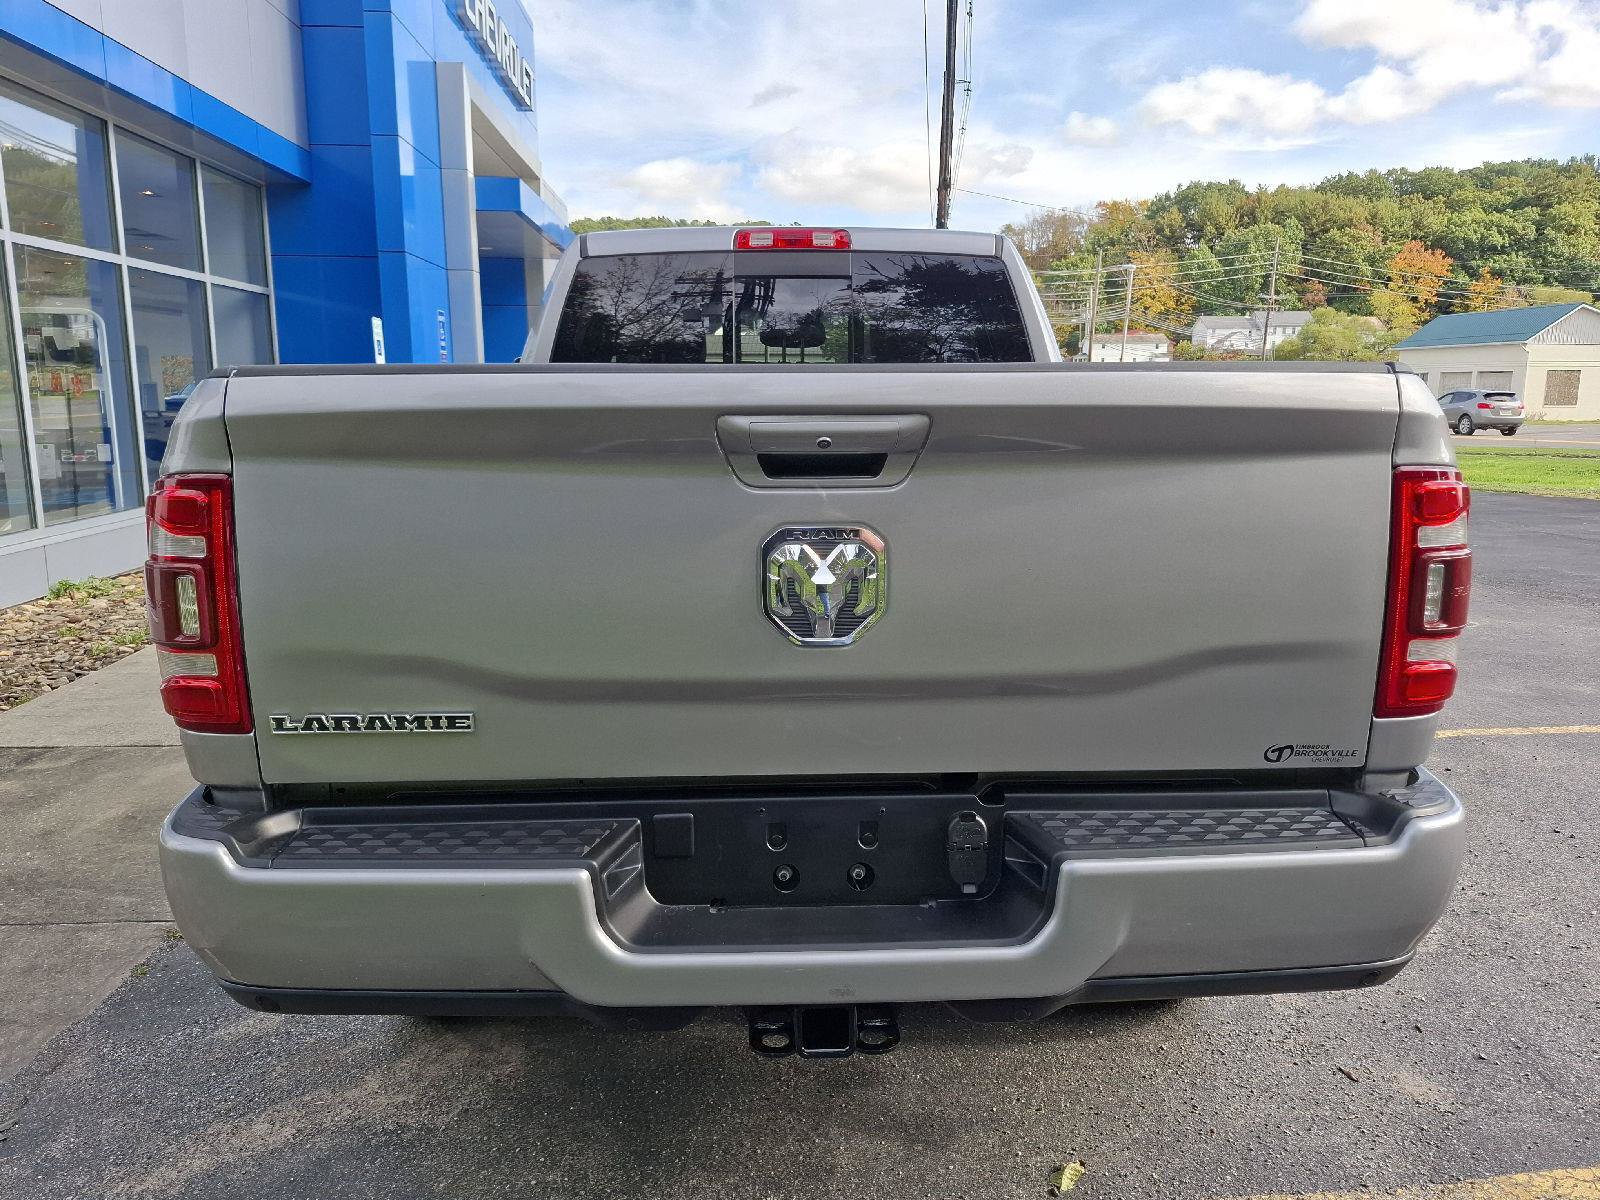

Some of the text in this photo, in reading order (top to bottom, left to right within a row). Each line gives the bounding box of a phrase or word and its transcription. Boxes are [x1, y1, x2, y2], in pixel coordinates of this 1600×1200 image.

[786, 528, 860, 540] RAM
[269, 713, 474, 734] LARAMIE
[1294, 749, 1359, 757] BROOKVILLE
